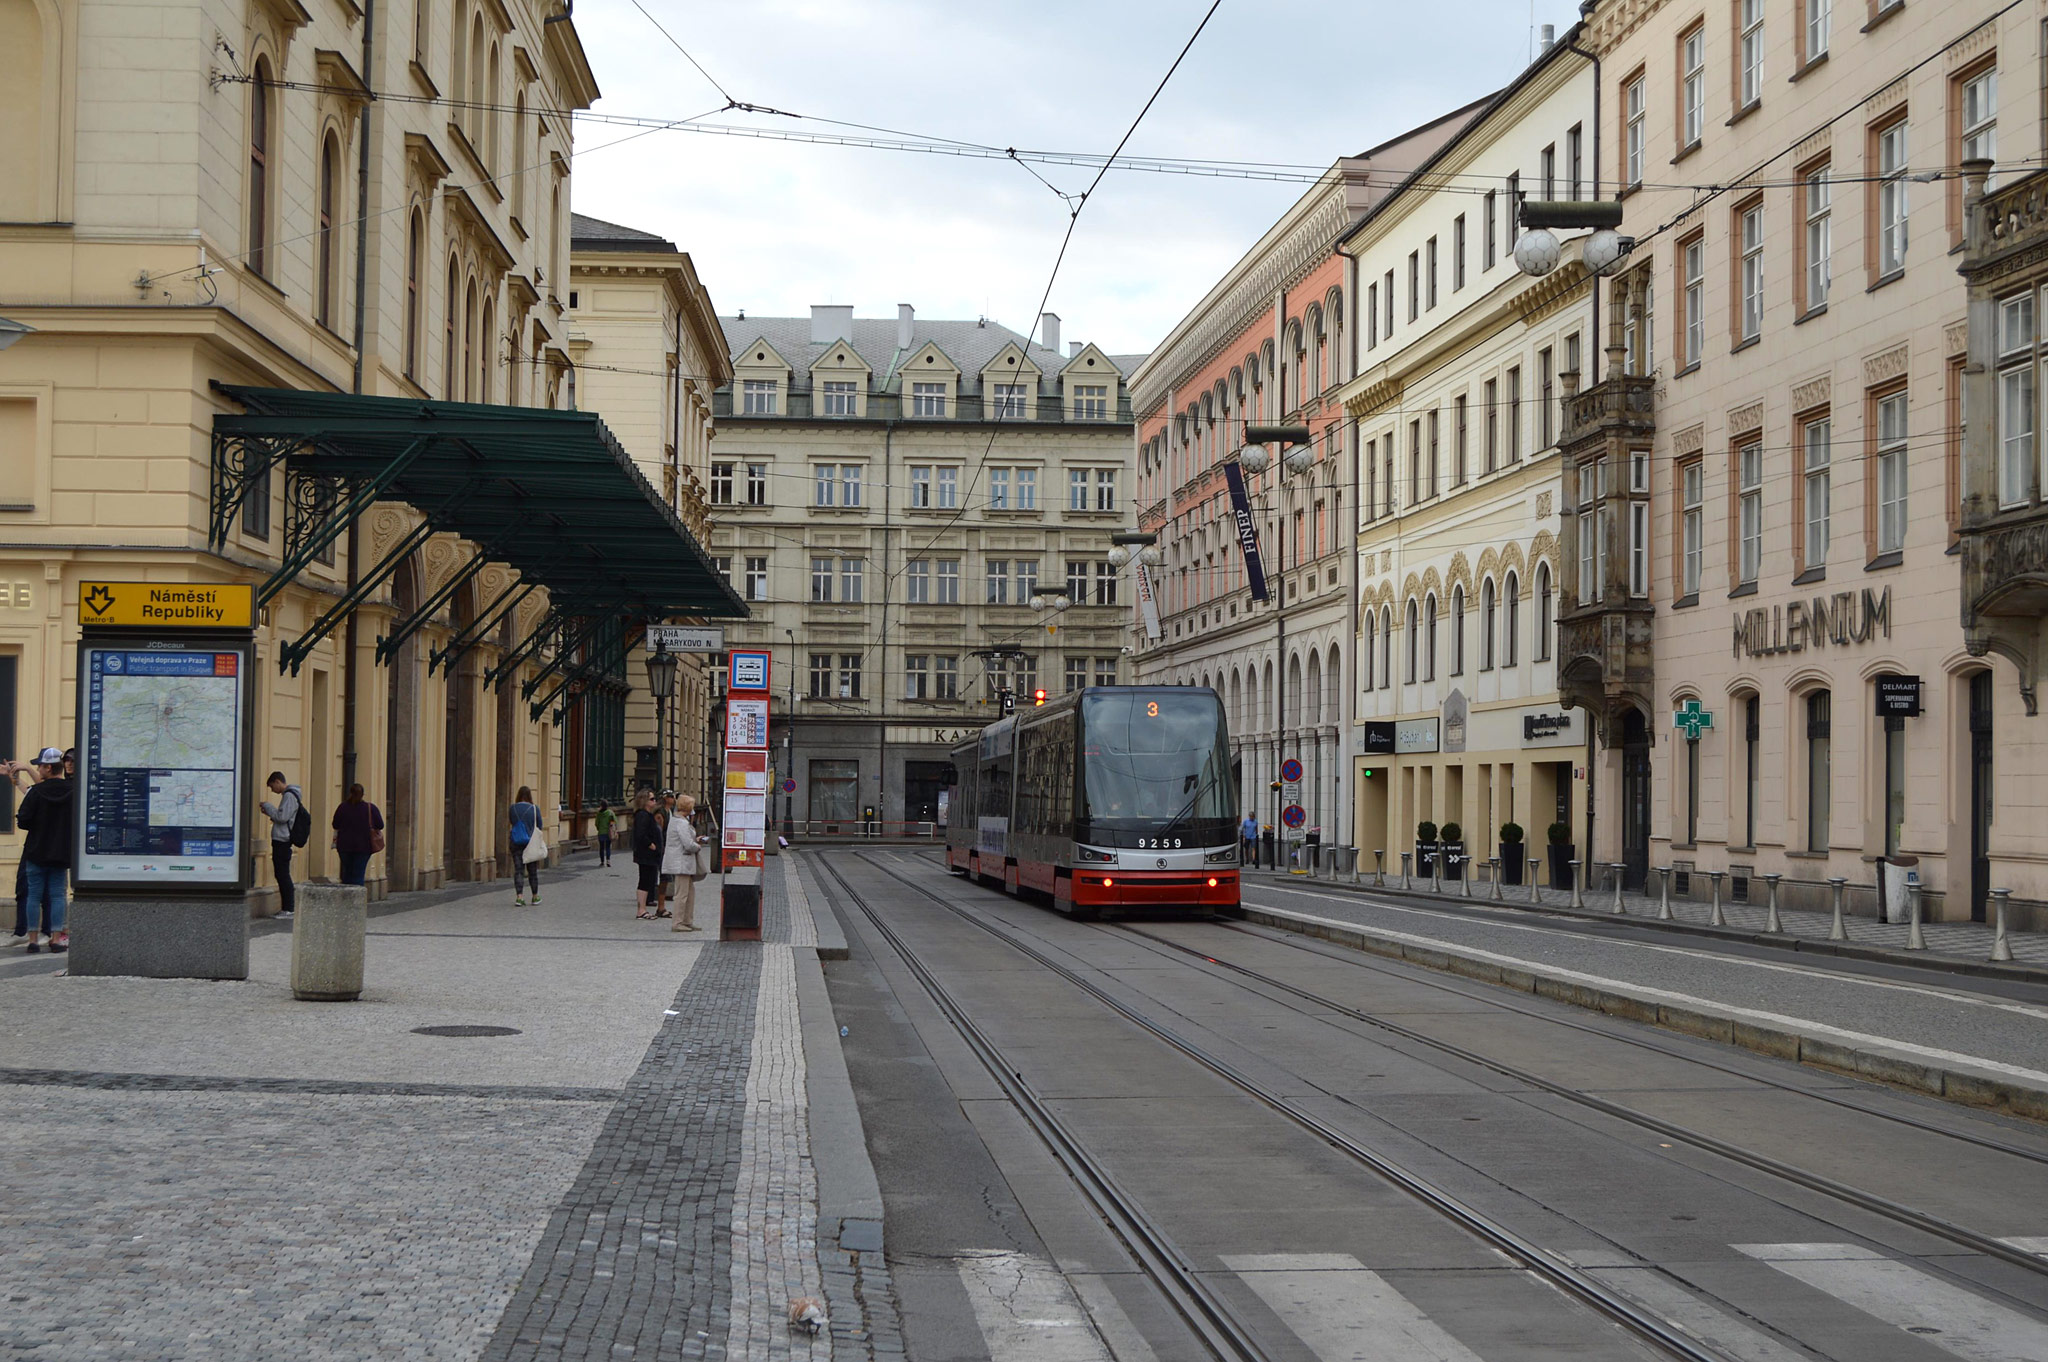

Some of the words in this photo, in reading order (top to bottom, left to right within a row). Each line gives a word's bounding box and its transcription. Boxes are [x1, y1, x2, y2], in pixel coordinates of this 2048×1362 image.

[1237, 509, 1256, 554] FINEP
[1136, 562, 1152, 602] MAXIMA
[150, 589, 217, 603] Náměstí
[142, 605, 224, 621] Republiky
[1733, 584, 1892, 660] MILLENNIUM
[146, 641, 185, 649] JCDecaux
[653, 639, 702, 647] MSARYKOVO
[129, 655, 154, 665] Veřejná
[155, 656, 182, 665] doprava
[129, 664, 149, 672] Public
[149, 665, 181, 673] transport
[188, 666, 212, 674] Prague
[1147, 702, 1158, 717] 3
